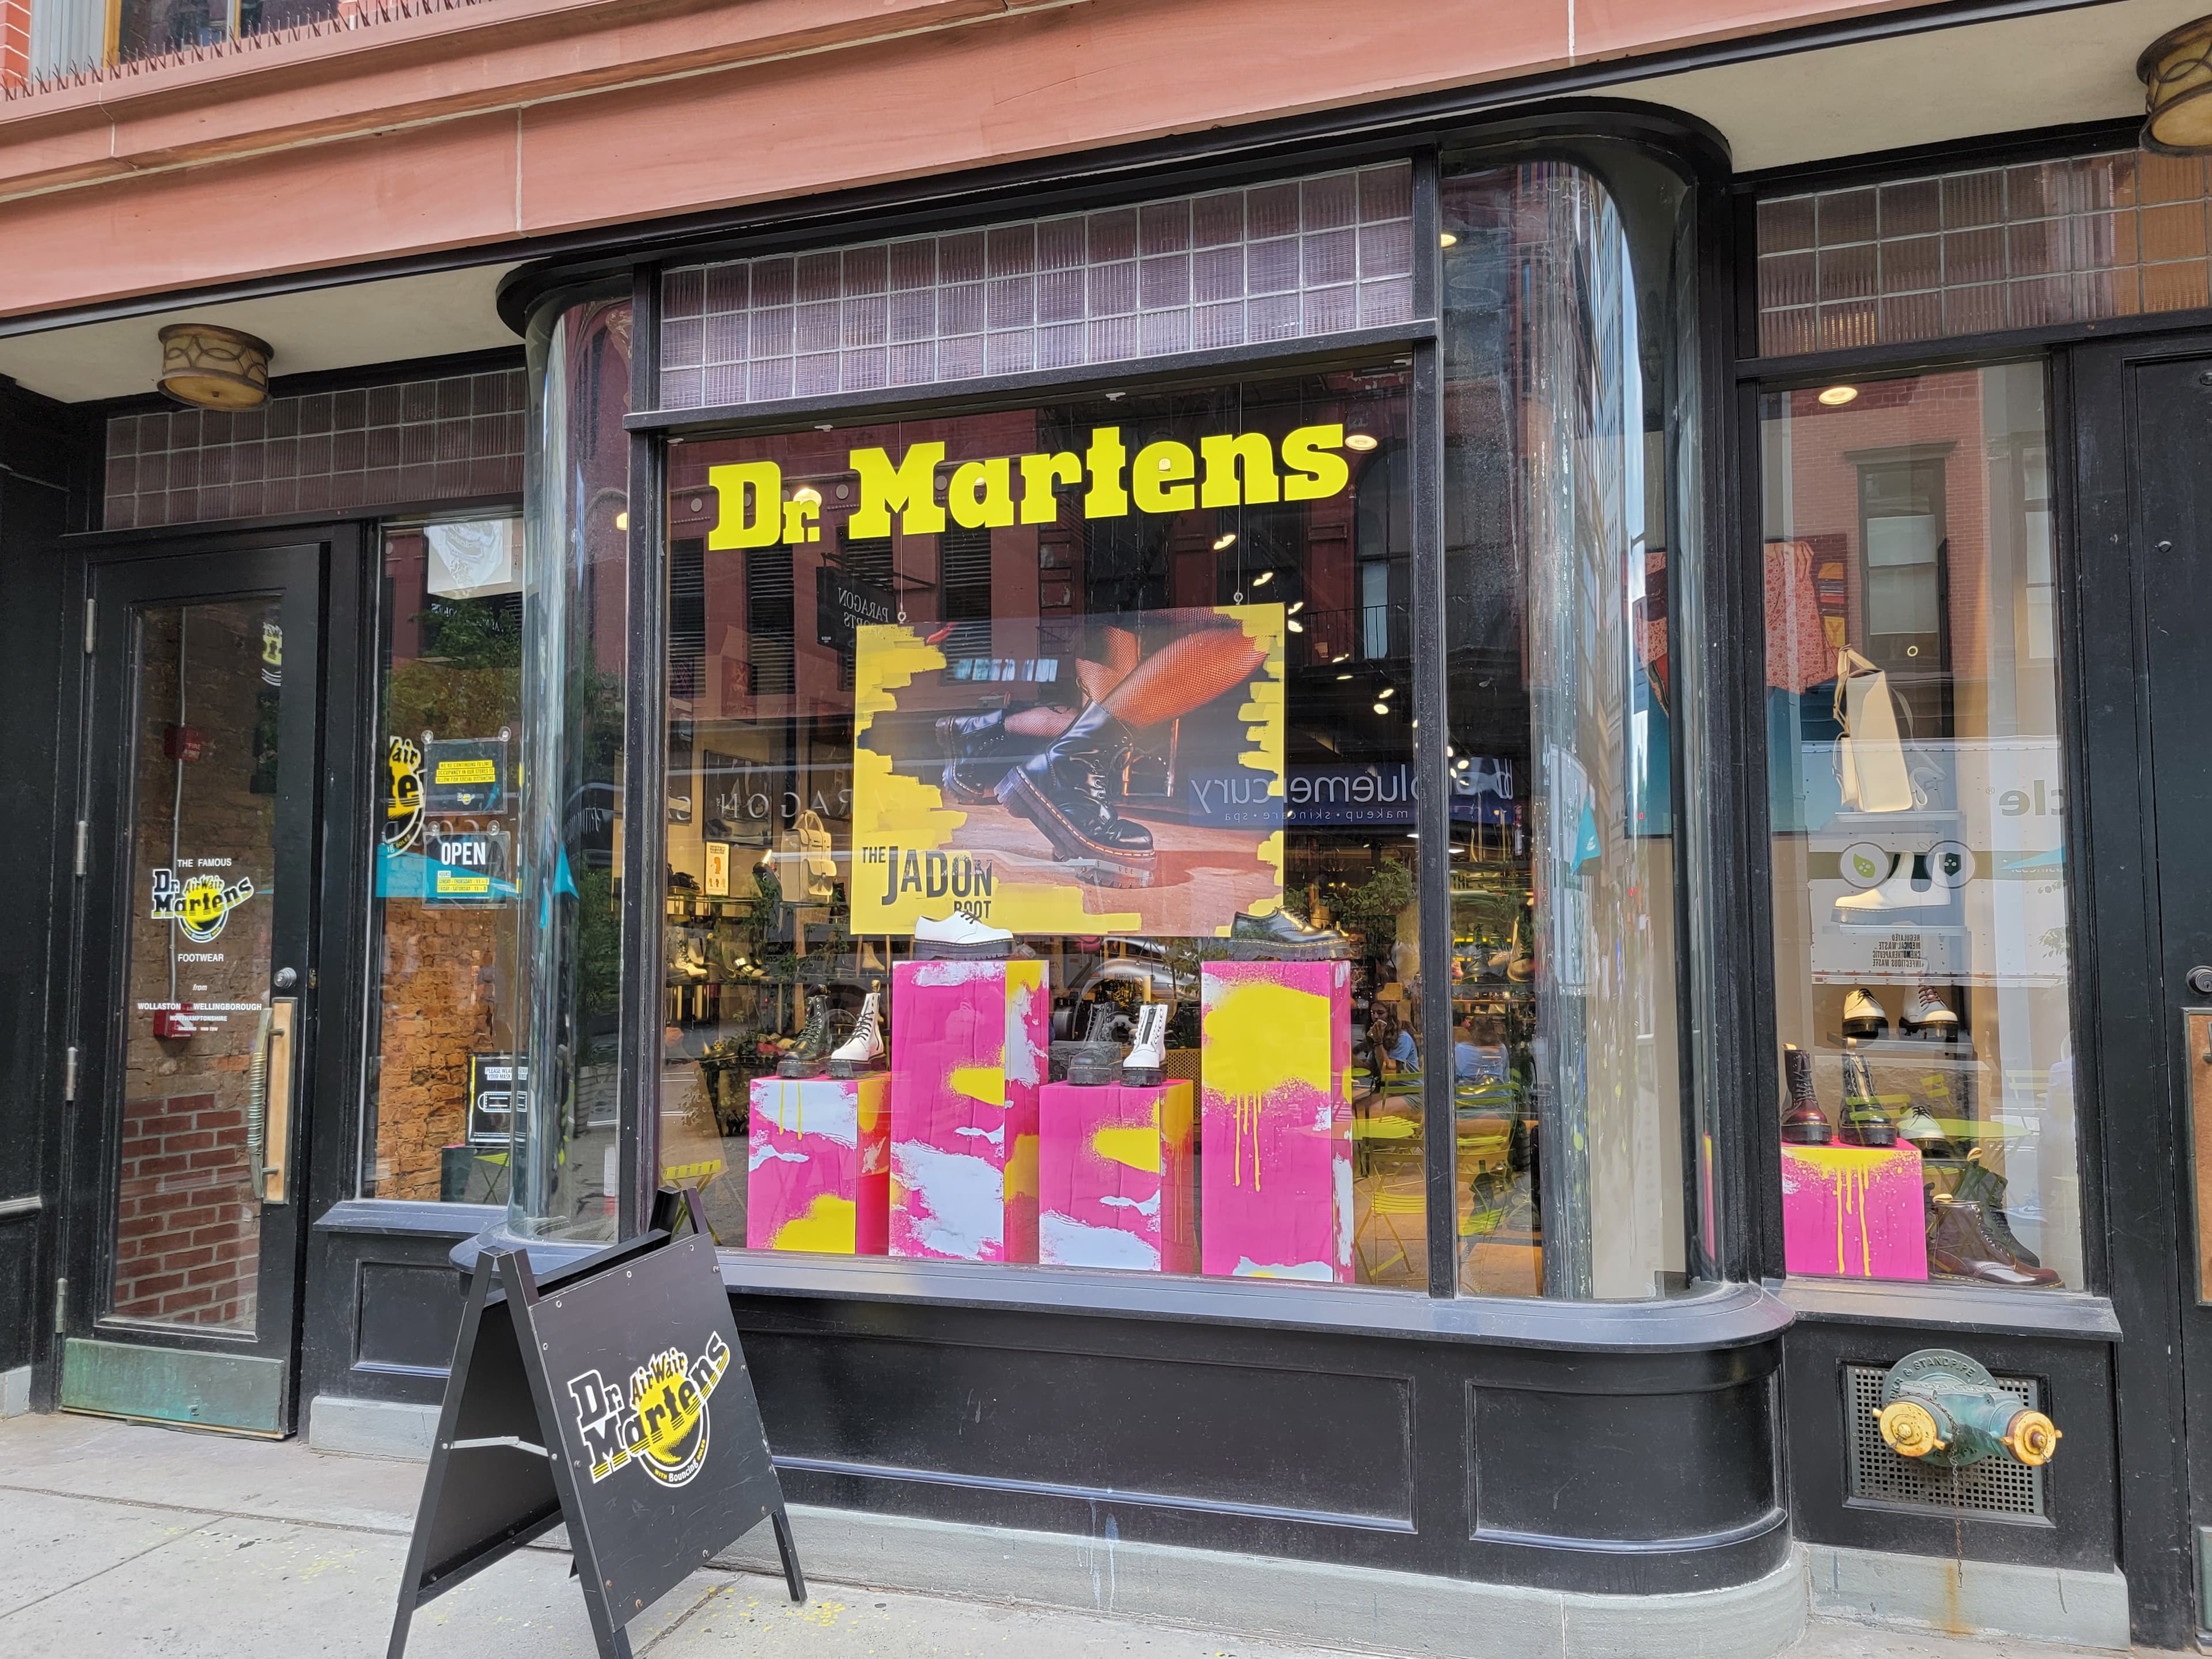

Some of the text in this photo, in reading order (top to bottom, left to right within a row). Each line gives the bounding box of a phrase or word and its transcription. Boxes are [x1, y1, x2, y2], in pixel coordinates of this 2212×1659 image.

[708, 423, 1350, 551] Dr. Martens
[177, 858, 232, 868] THE FAMOUS
[441, 842, 486, 865] OPEN
[861, 846, 886, 863] THE
[153, 869, 180, 893] Dr.
[184, 875, 225, 894] AirWair
[881, 846, 993, 906] JADON
[152, 877, 254, 918] Martens
[953, 900, 992, 919] BOOT
[177, 953, 224, 963] FOOTWEAR
[1914, 1355, 1976, 1377] STANDPIPE
[630, 1347, 688, 1410] AirWair
[567, 1369, 625, 1427] Dr.
[582, 1331, 730, 1483] Martens
[654, 1438, 706, 1482] WITH Bouncing SOLES
